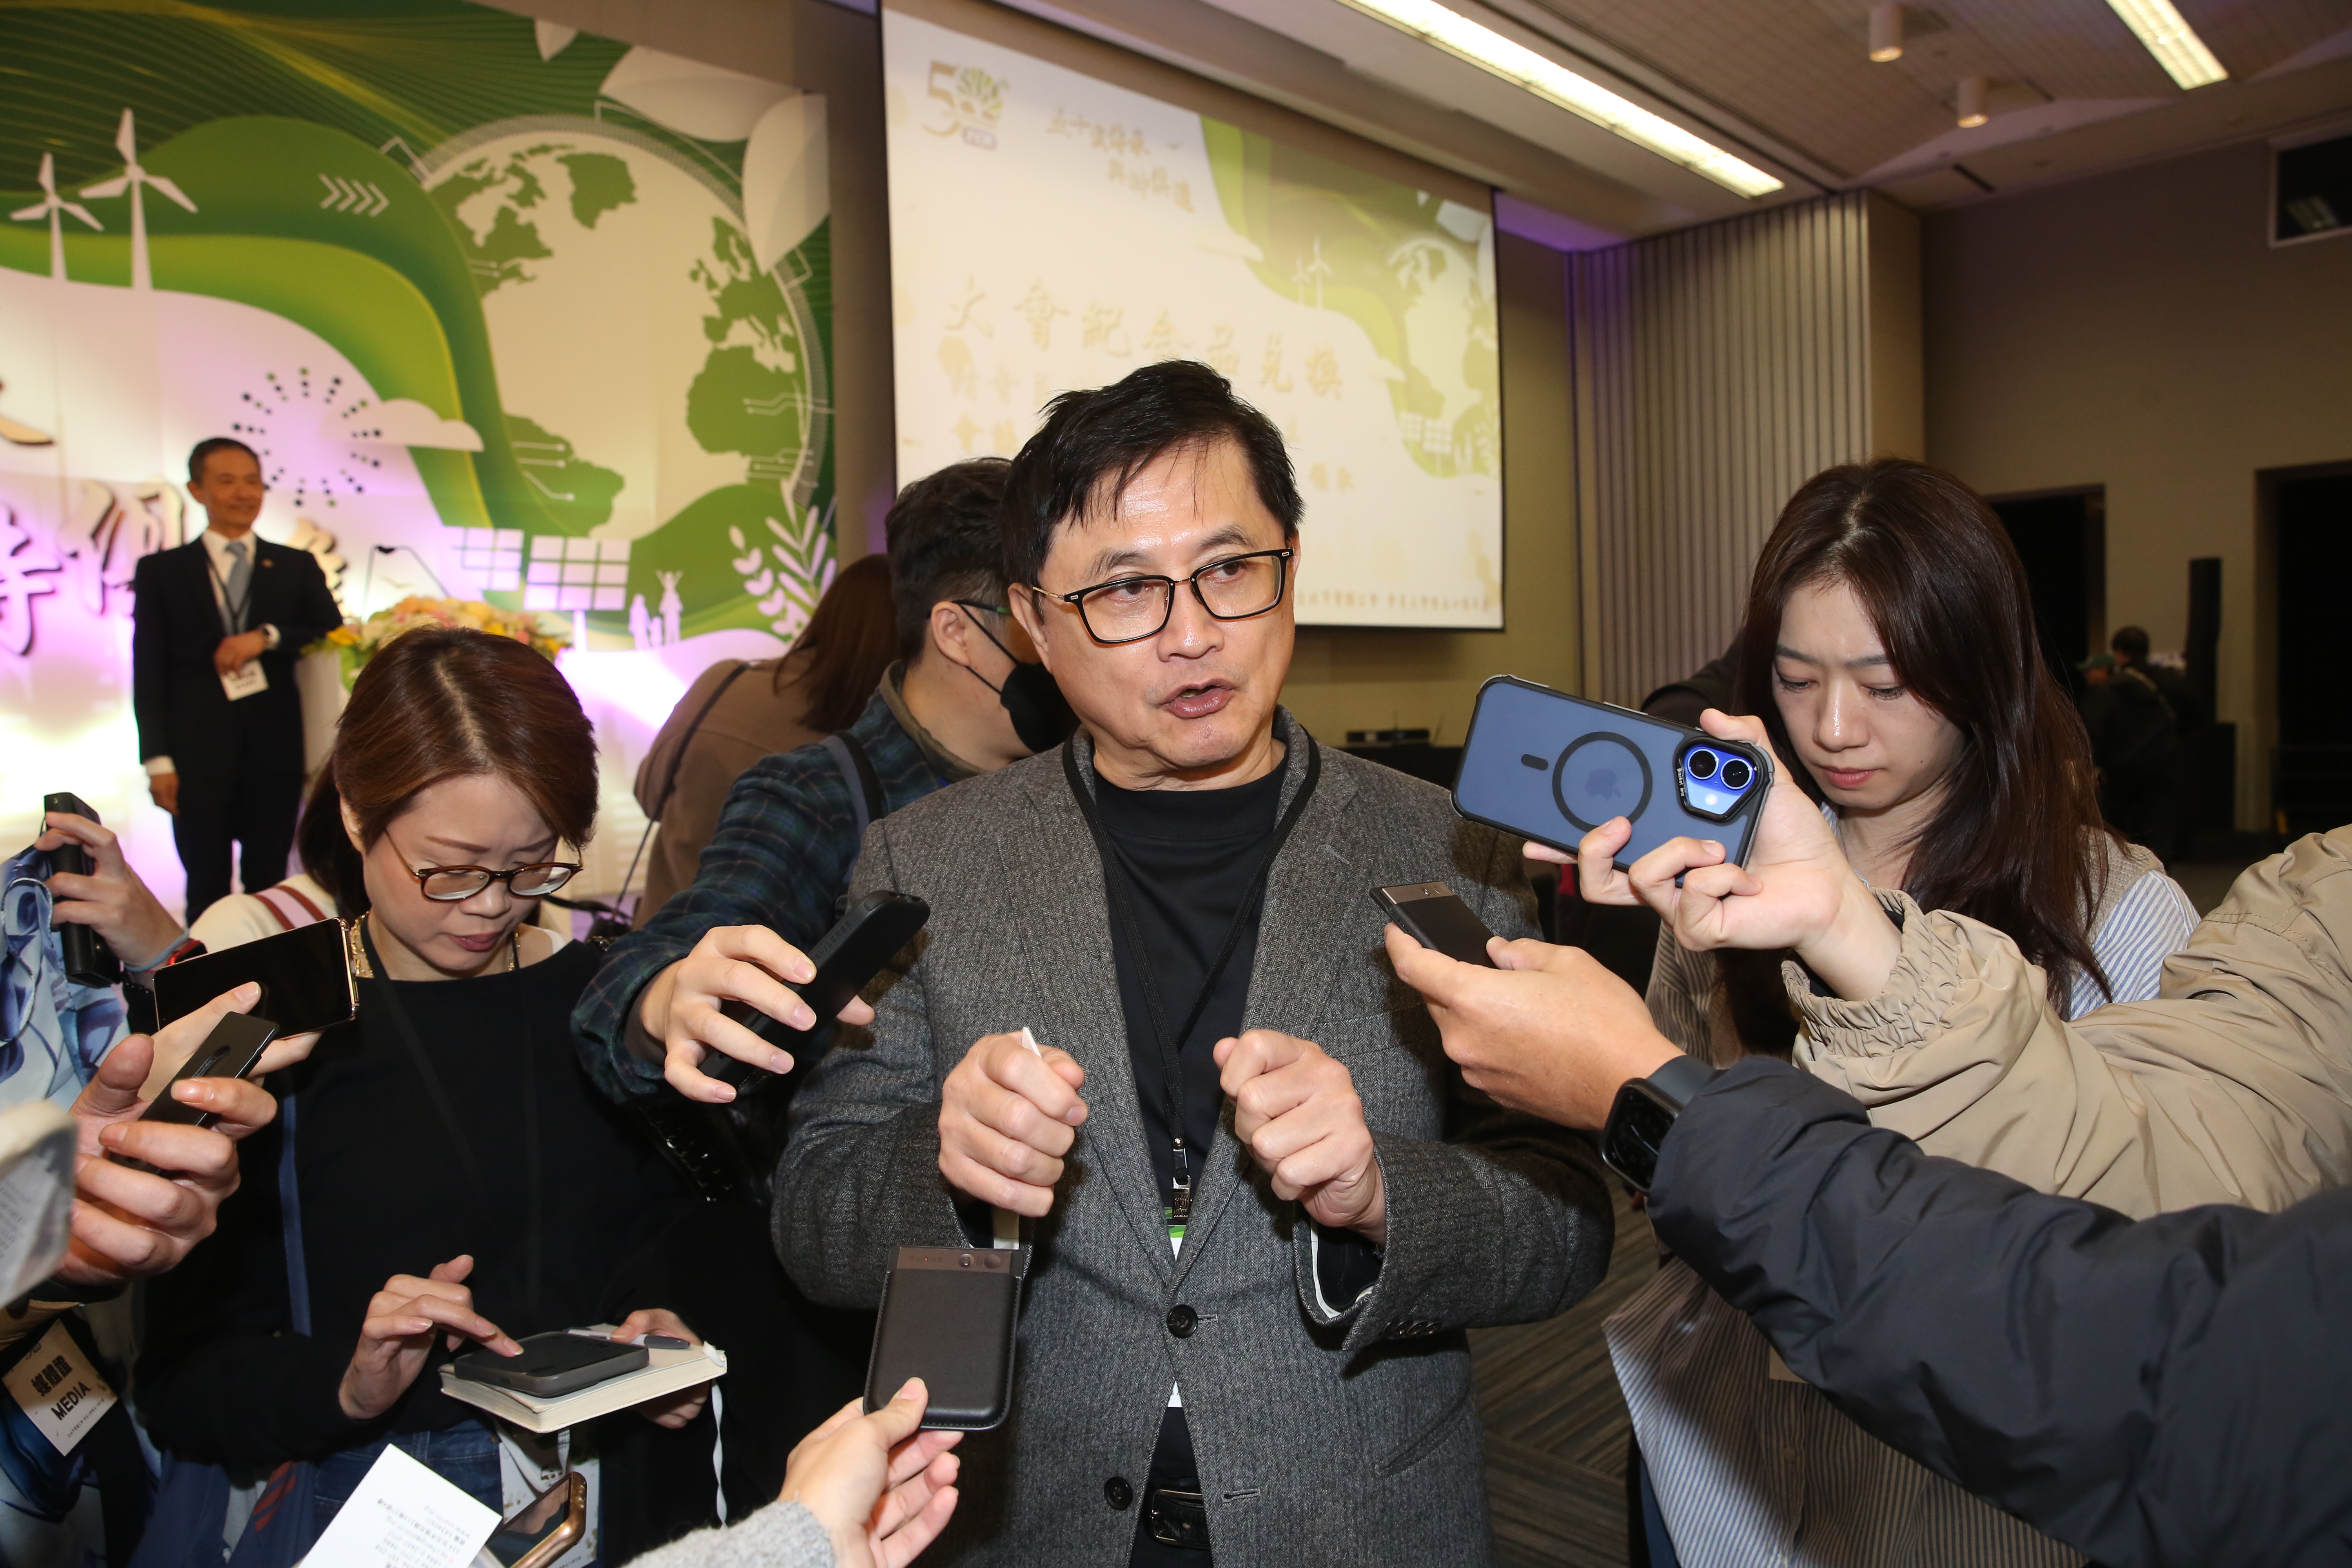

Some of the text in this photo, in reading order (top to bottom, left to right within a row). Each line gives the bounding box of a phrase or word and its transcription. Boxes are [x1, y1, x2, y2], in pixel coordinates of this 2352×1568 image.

[31, 1355, 73, 1397] 媒體證
[51, 1381, 91, 1420] MEDIA
